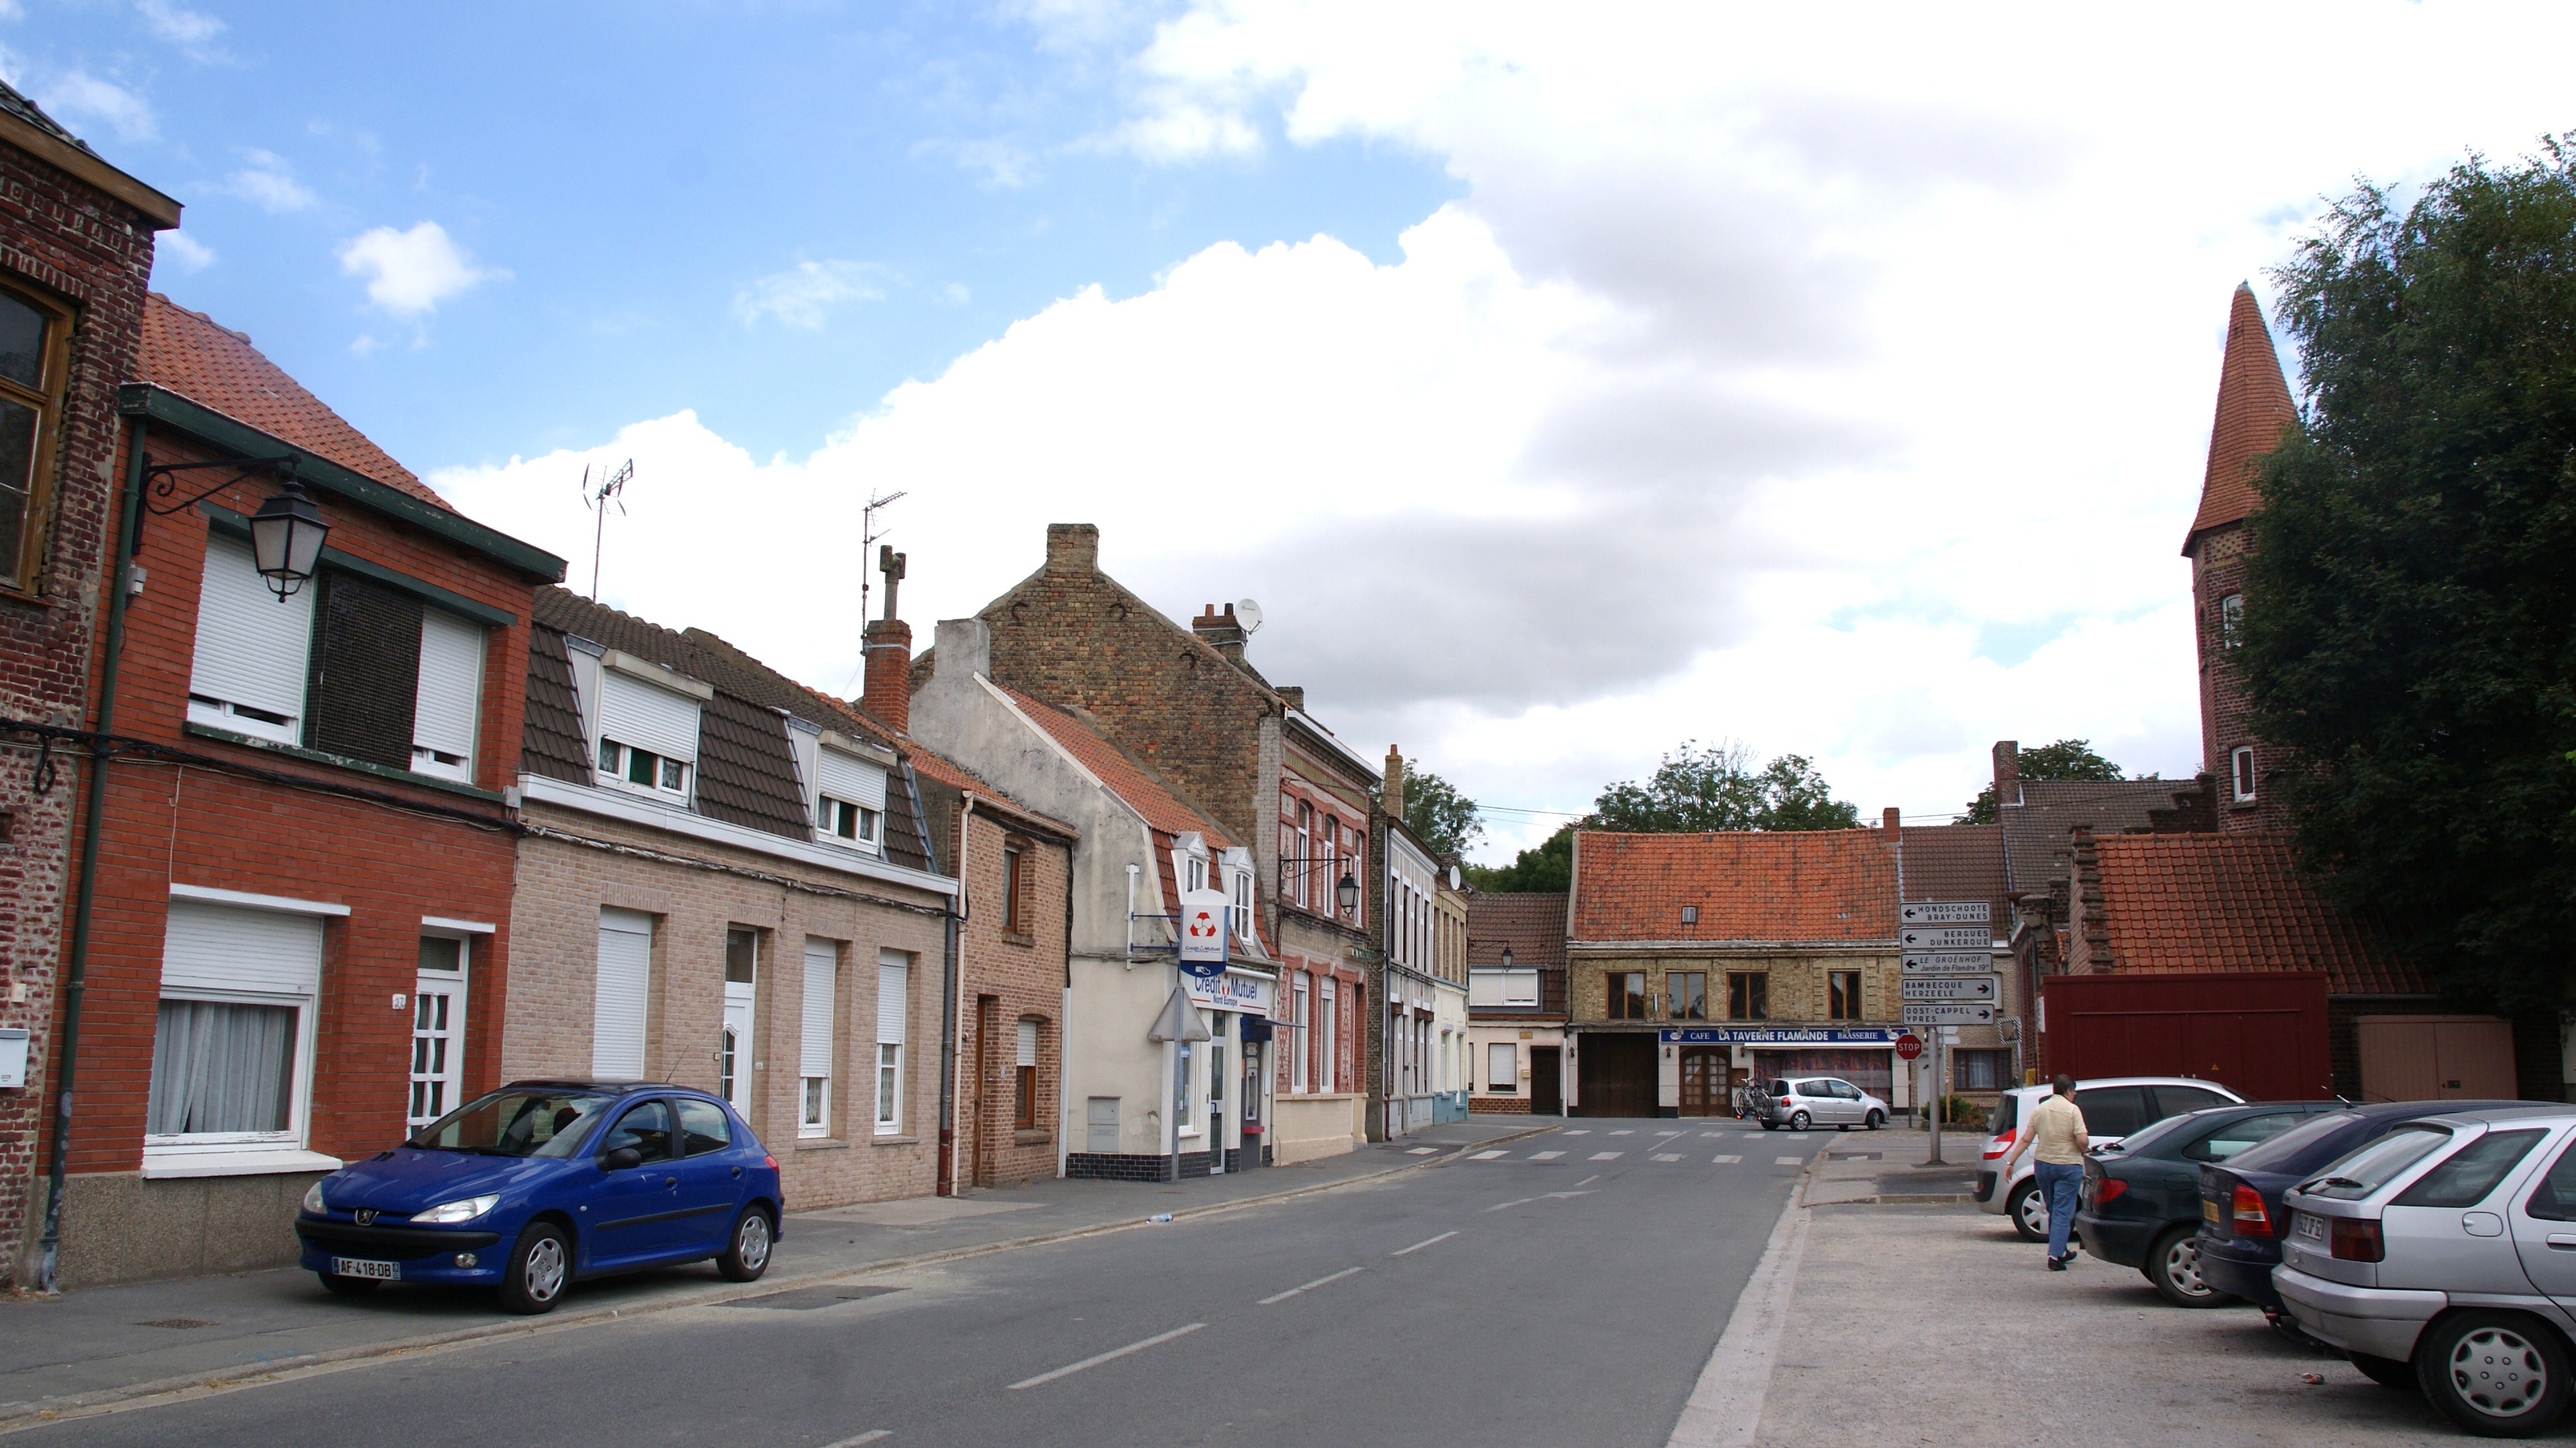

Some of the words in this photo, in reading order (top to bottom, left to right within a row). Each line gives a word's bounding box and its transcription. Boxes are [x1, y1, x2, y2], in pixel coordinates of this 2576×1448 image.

[1231, 977, 1257, 999] Mutuel
[1213, 995, 1223, 1004] Nord
[1224, 996, 1237, 1007] Europe
[1718, 1031, 1730, 1041] LA
[1732, 1031, 1775, 1041] TAVERNE
[1777, 1031, 1828, 1041] FLAMANDE
[1898, 1043, 1920, 1052] STOP
[341, 1260, 391, 1277] AF-418-DB
